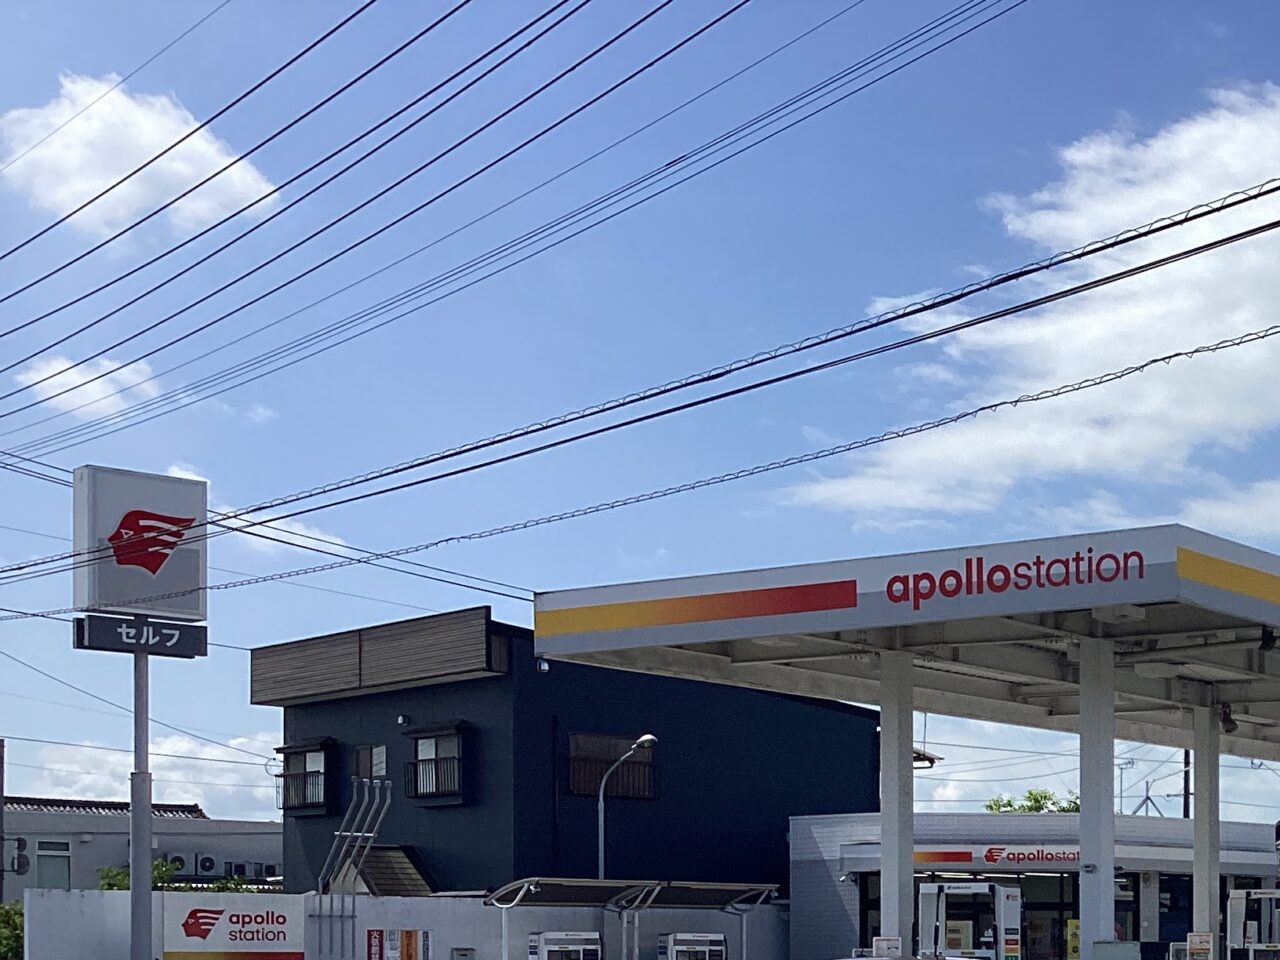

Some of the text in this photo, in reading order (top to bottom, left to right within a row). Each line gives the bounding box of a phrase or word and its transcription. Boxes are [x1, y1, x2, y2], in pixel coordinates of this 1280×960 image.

[886, 547, 1144, 611] apollostation
[117, 624, 180, 647] セルフ
[1007, 849, 1080, 864] apollostat
[228, 910, 287, 928] apollo
[228, 928, 287, 942] station
